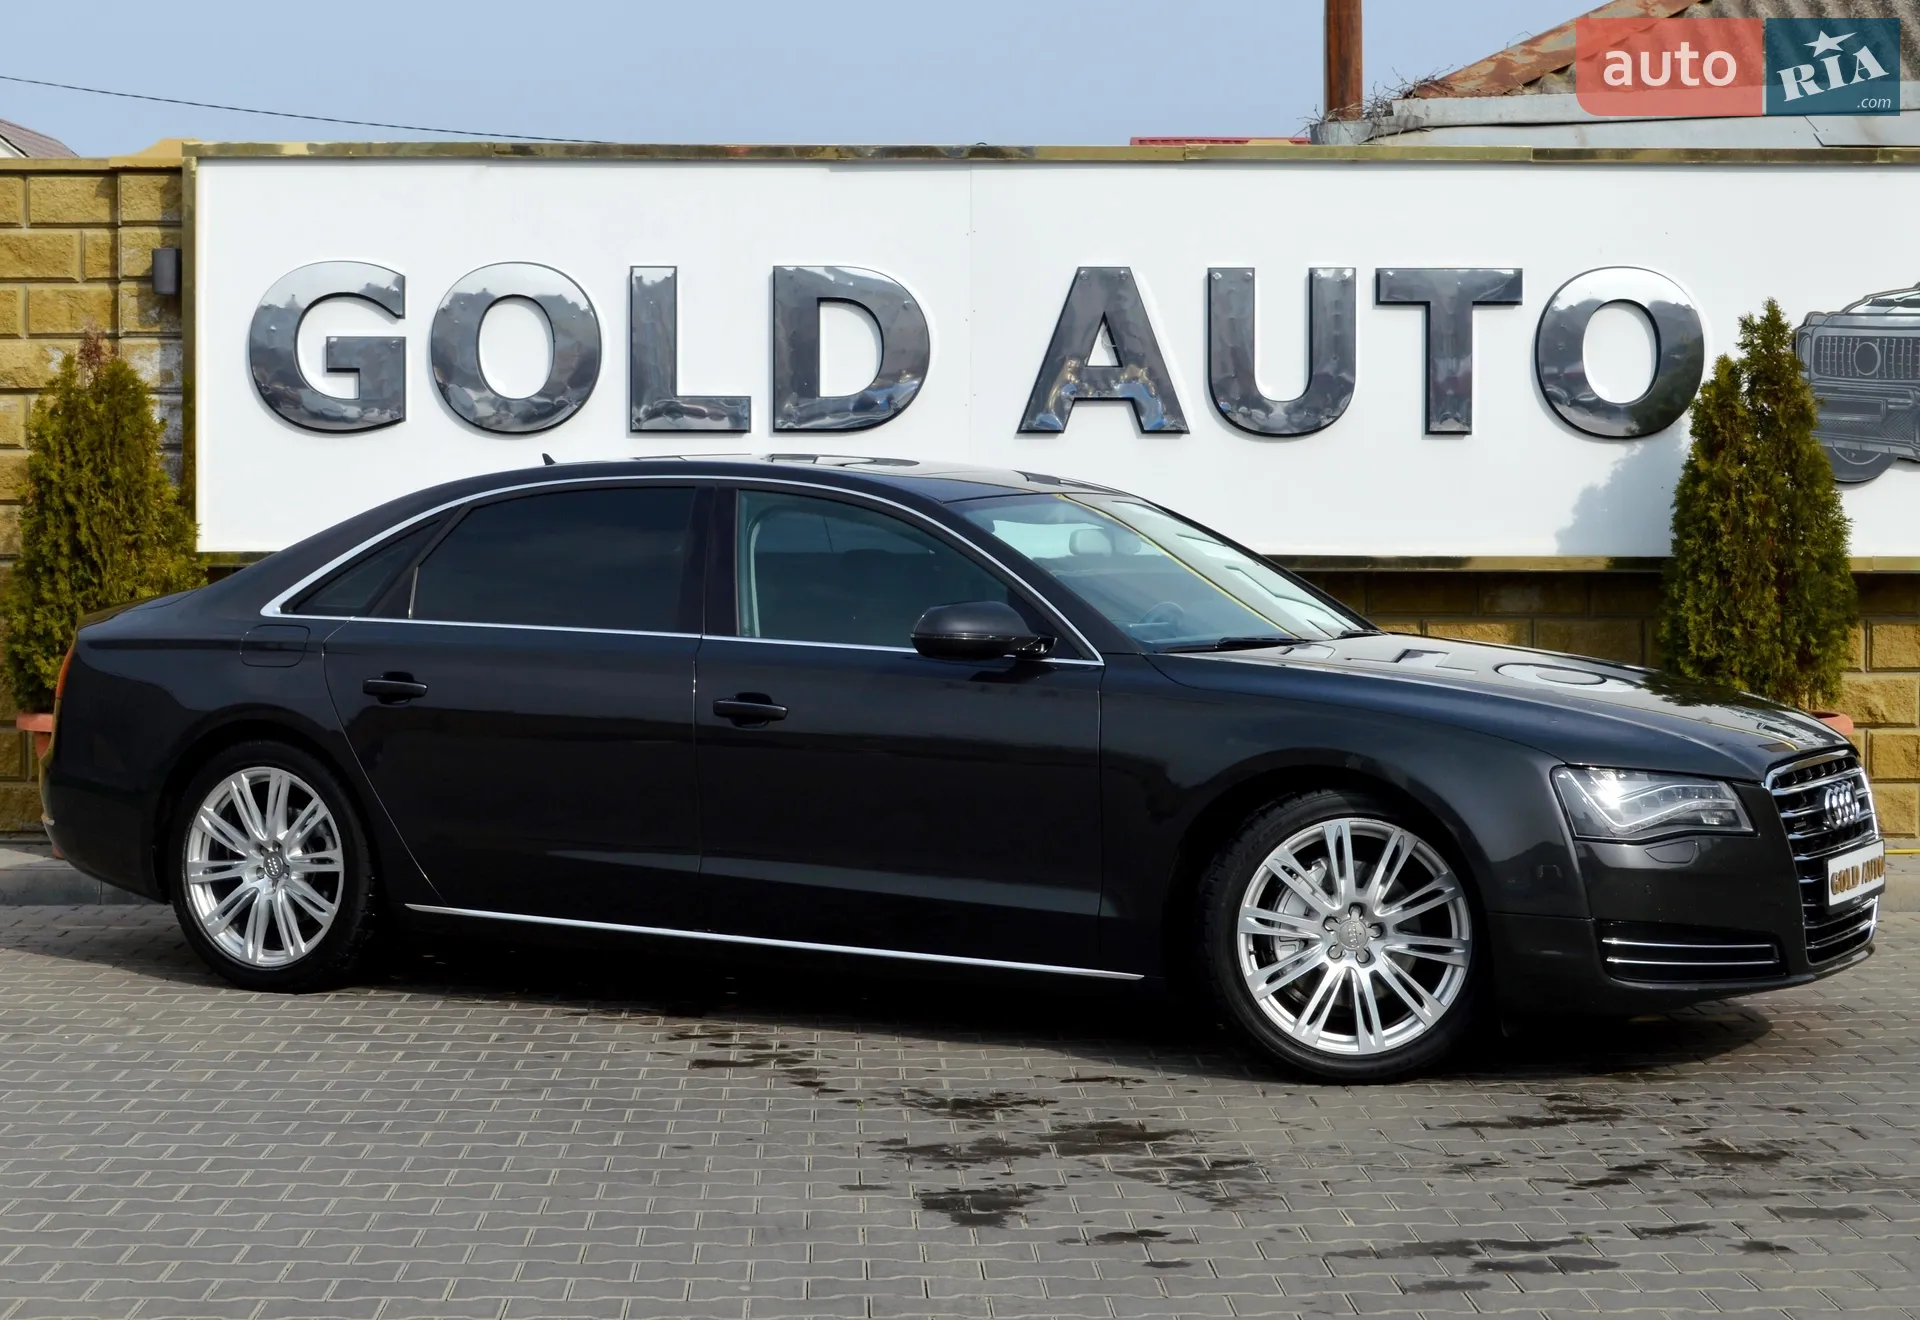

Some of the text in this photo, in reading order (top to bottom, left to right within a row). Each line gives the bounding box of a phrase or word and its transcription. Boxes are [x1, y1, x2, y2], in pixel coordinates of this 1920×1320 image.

[248, 260, 1706, 440] GOLD AUTO
[1831, 855, 1885, 896] GOLD AUTO
